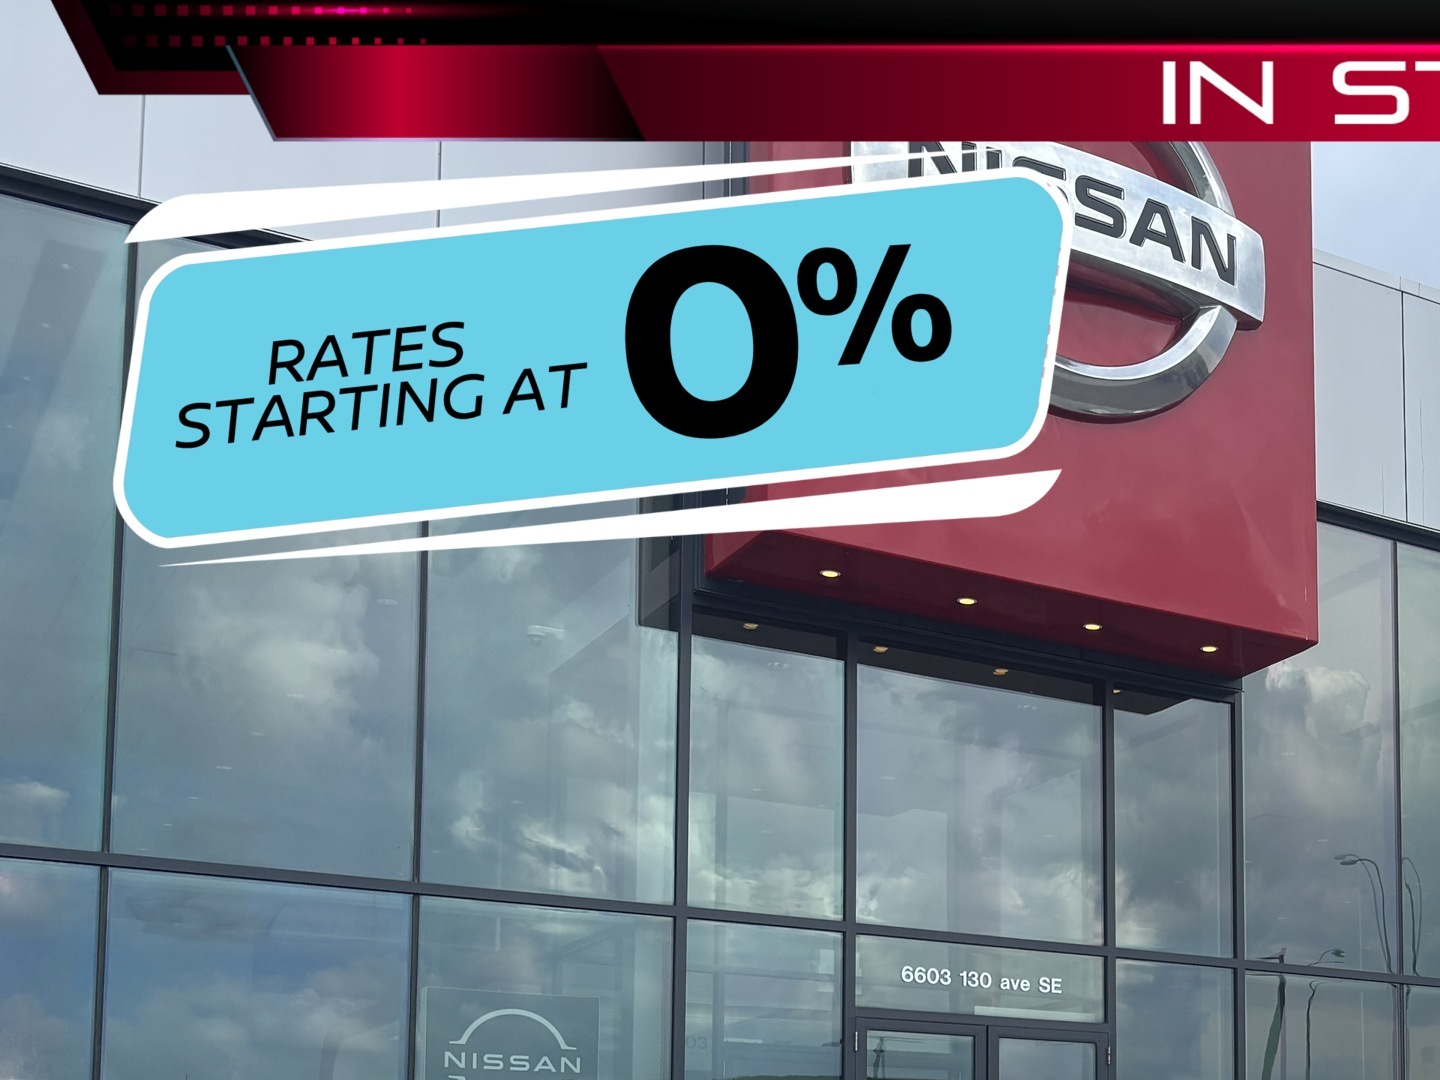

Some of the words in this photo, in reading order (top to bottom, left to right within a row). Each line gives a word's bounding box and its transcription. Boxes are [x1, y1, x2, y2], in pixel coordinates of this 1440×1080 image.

[901, 965, 952, 986] 6603
[959, 971, 992, 988] 130
[1000, 977, 1031, 992] ave
[1038, 976, 1062, 994] SE
[444, 1051, 581, 1074] NISSAN
